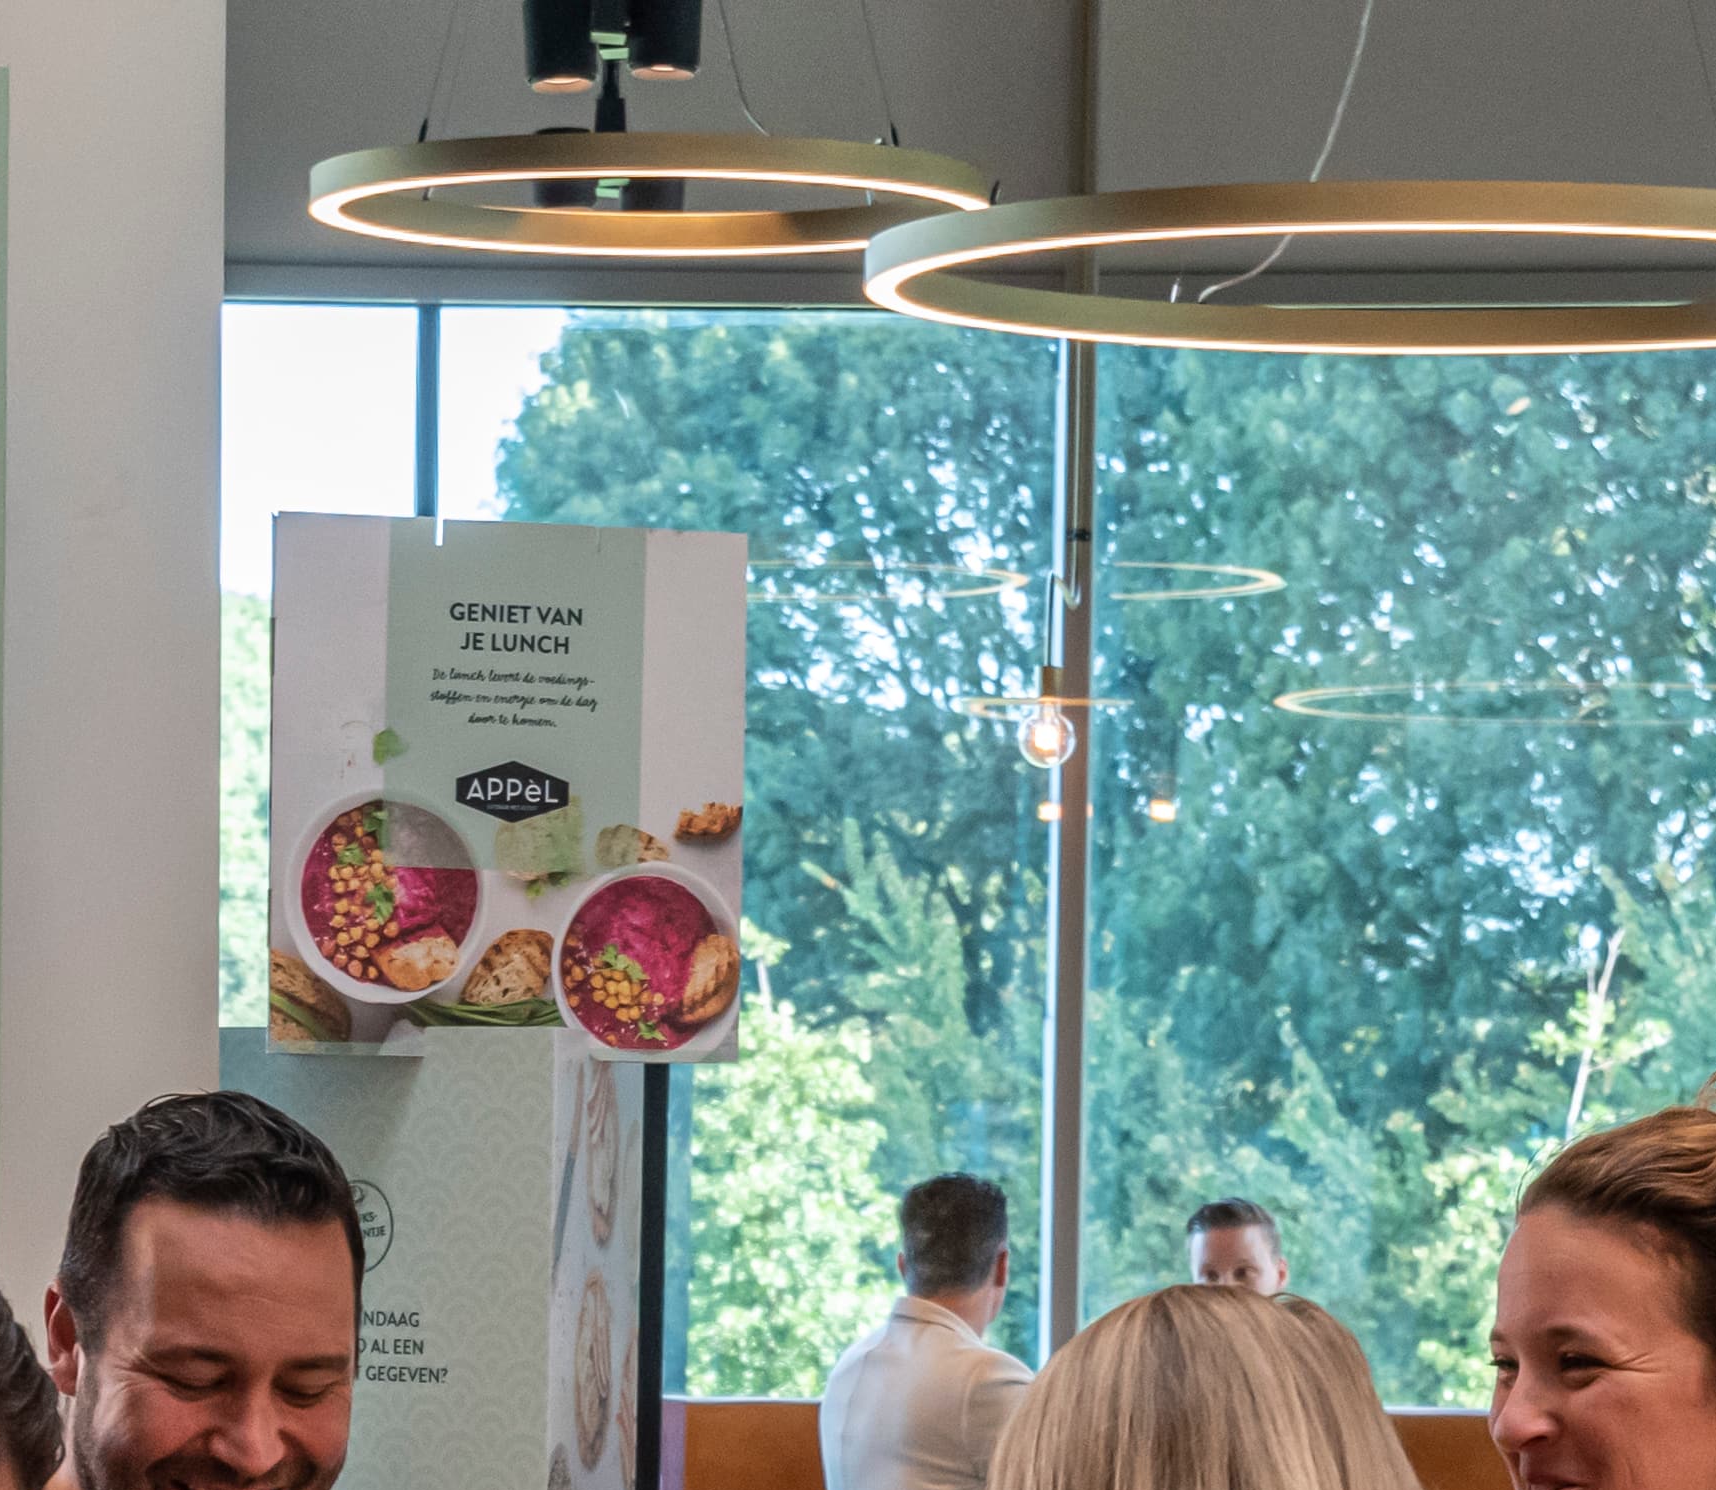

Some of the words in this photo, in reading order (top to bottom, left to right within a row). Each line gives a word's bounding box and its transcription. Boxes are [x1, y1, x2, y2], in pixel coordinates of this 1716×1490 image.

[449, 602, 531, 624] GENIET
[537, 606, 583, 626] VAN
[460, 632, 485, 651] JE
[491, 634, 569, 655] LUNCH
[432, 668, 446, 680] De
[449, 668, 485, 681] lunch
[523, 671, 535, 683] de
[430, 690, 473, 705] stoffen
[475, 693, 491, 703] en
[575, 695, 597, 712] dag
[361, 1311, 419, 1329] NDAAG
[370, 1338, 389, 1354] AL
[394, 1339, 424, 1355] EEN
[365, 1365, 448, 1384] GEGEVEN?
